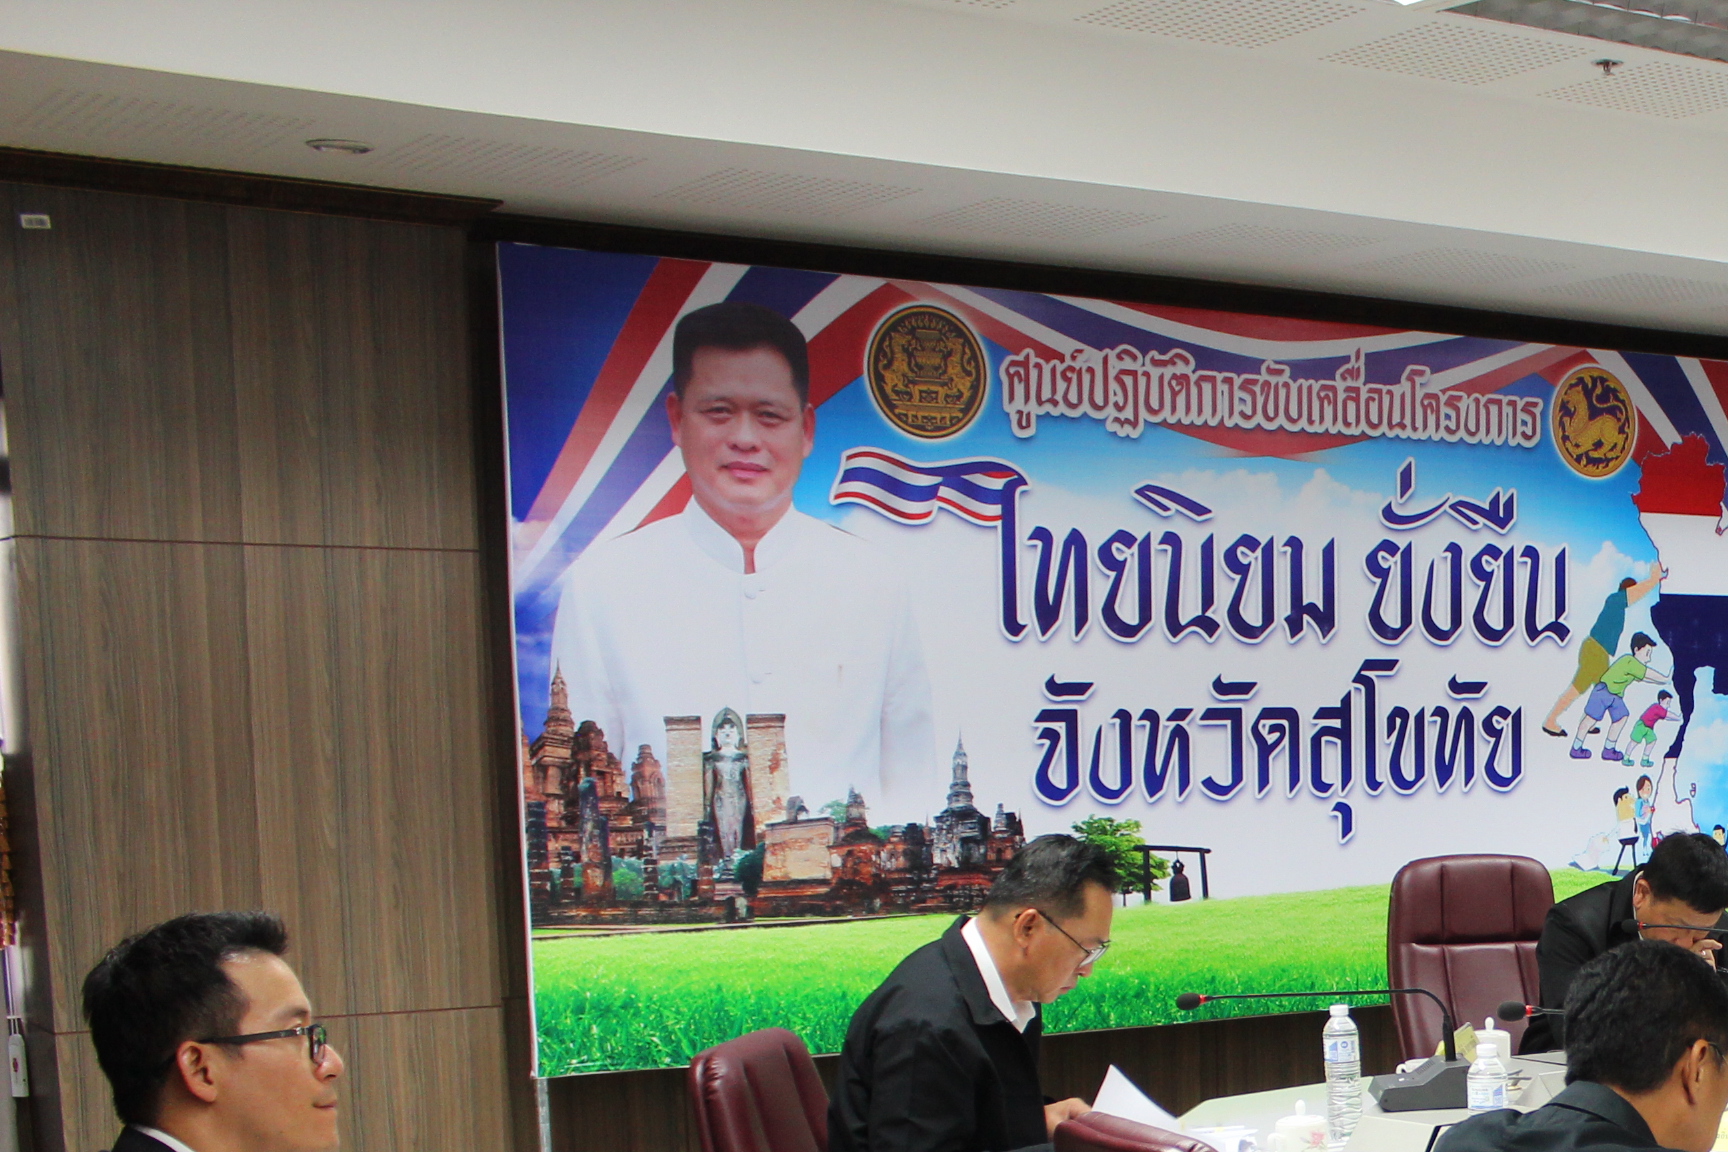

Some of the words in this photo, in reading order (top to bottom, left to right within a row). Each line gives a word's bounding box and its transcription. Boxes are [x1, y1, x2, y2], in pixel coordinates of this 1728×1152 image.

[1003, 346, 1542, 446] ศูนย์ปฏิบัติการขับเคลื่อนโครงการ
[998, 470, 1338, 643] ไทยนิยม
[1364, 459, 1573, 647] ยั่งยืน
[1033, 659, 1525, 843] จังหวัดสุโขทัย
